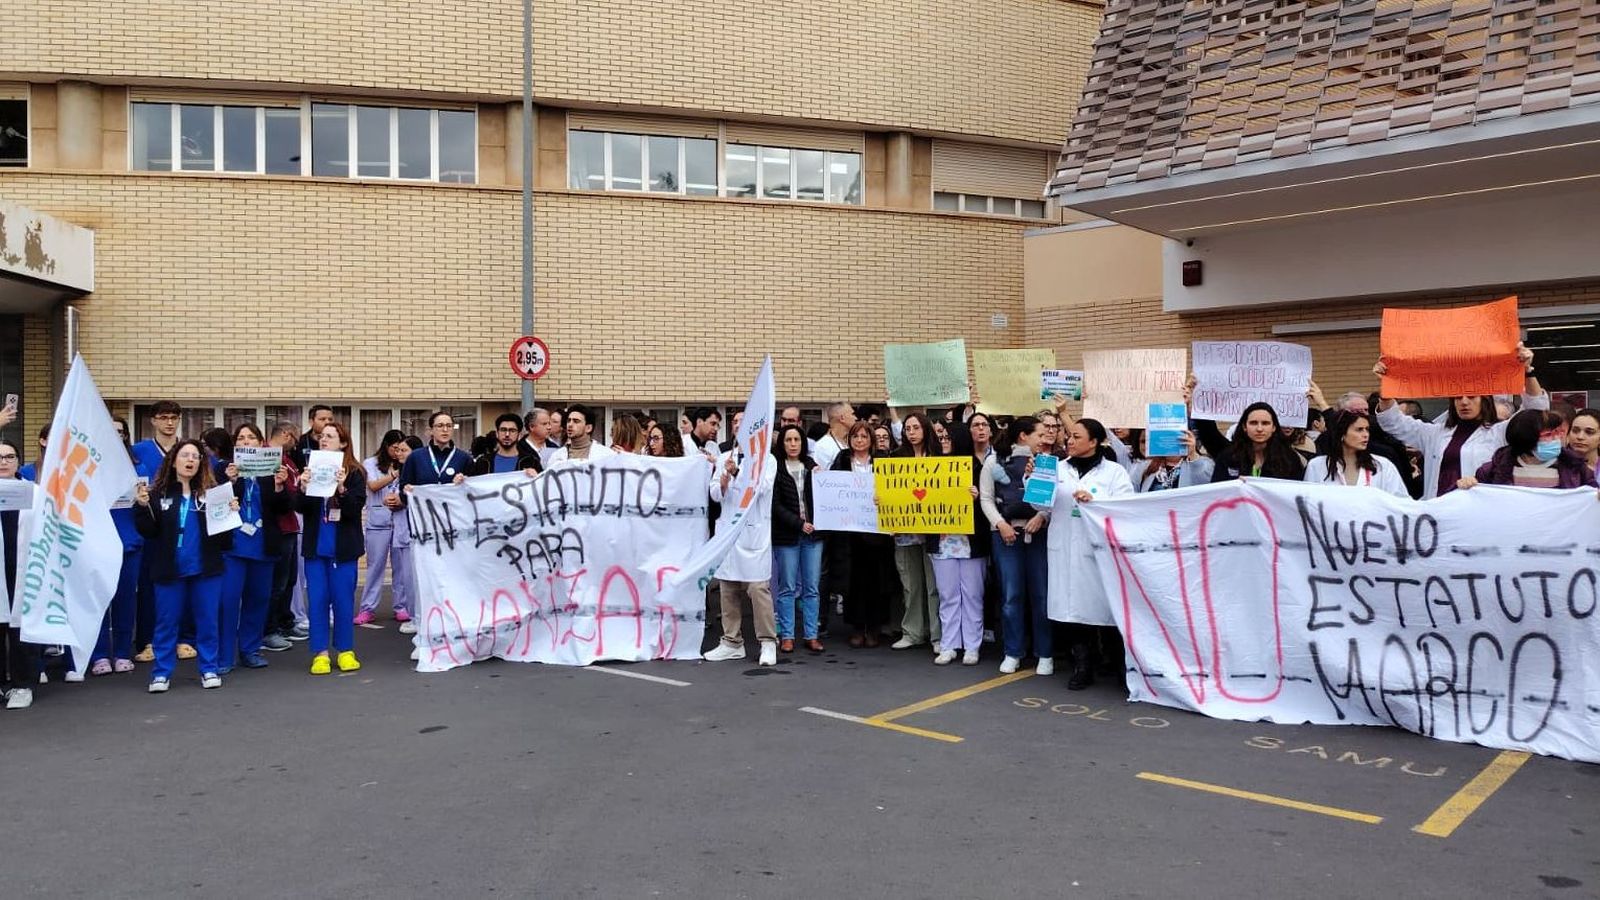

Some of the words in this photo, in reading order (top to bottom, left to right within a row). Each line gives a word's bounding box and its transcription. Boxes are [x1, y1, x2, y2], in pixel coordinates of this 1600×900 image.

[467, 464, 662, 549] ESTATUTO
[497, 527, 585, 581] PARA
[1104, 496, 1283, 705] NO
[1295, 495, 1439, 571] NUEVO
[1307, 568, 1597, 632] ESTATUTO
[1012, 696, 1171, 729] SOLO
[1309, 632, 1563, 743] MARCO
[1243, 735, 1448, 778] SAMU
